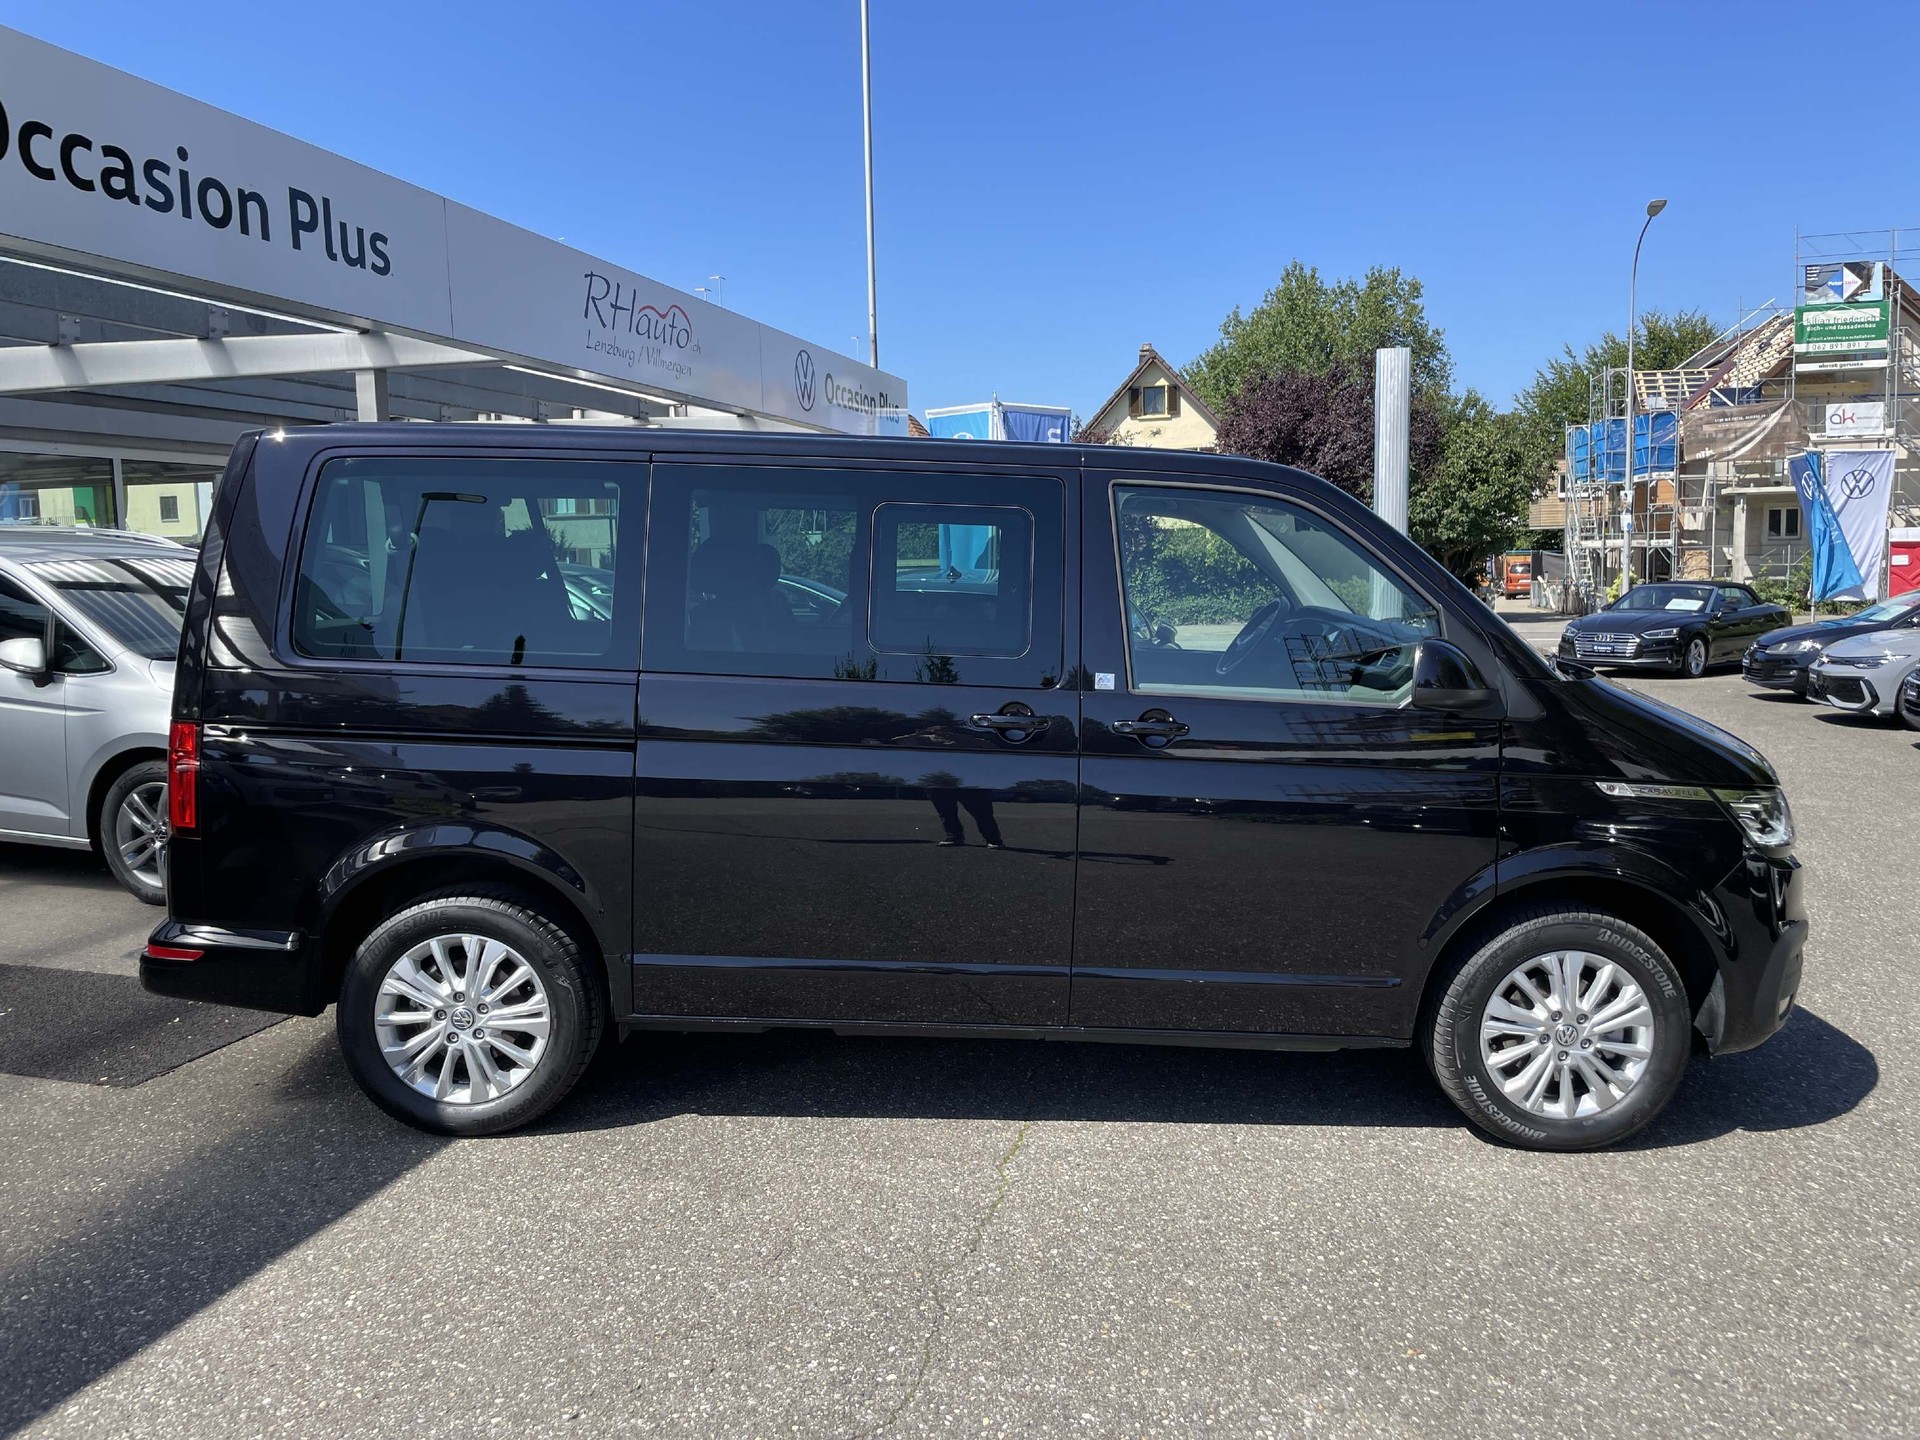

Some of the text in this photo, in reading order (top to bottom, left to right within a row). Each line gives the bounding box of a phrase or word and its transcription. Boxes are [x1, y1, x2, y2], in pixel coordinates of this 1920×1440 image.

[0, 98, 392, 277] ccasion Plus
[1806, 315, 1877, 325] kilian friederich
[586, 329, 636, 368] Lenzburg
[645, 345, 693, 380] Villmergen
[1812, 343, 1826, 351] 062
[1829, 342, 1843, 350] 891
[824, 373, 876, 416] Occasion
[879, 391, 900, 425] Plus
[1829, 408, 1855, 425] ak
[1595, 927, 1678, 1000] BRIDGESTONE
[1463, 1075, 1547, 1142] BRIDGESTONE
